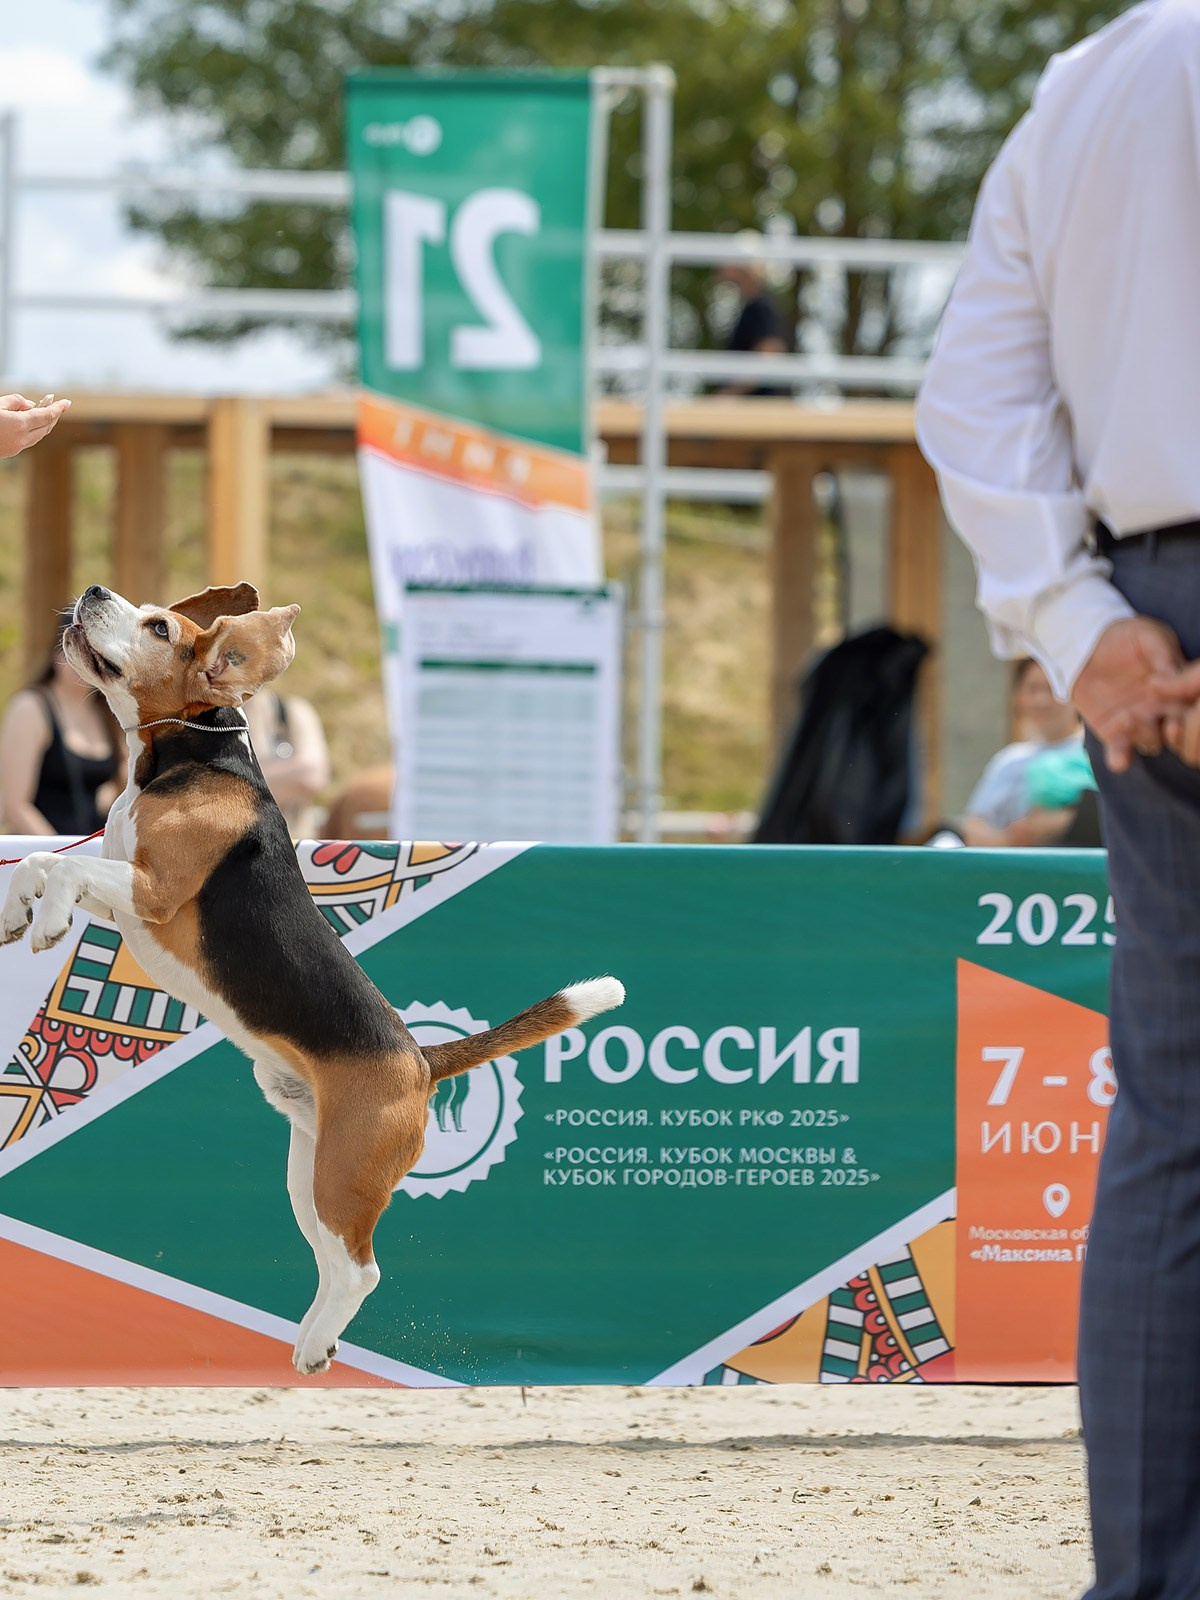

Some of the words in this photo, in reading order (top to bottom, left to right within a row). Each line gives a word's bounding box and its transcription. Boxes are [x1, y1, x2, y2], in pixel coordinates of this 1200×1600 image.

[544, 1025, 860, 1084] РОССИЯ
[981, 1046, 1025, 1106] 7
[544, 1109, 653, 1127] «РОССИЯ.
[660, 1109, 733, 1127] КУБОК
[739, 1109, 784, 1127] РКФ
[790, 1109, 849, 1127] 2025»
[981, 1121, 1099, 1154] ИЮН
[544, 1147, 653, 1165] «РОССИЯ.
[660, 1147, 732, 1165] КУБОК
[738, 1147, 835, 1165] МОСКВЫ
[841, 1147, 857, 1164] &
[543, 1169, 617, 1187] КУБОК
[623, 1169, 815, 1189] ГОРОДОВ-ГЕРОЕВ
[820, 1169, 881, 1187] 2025»
